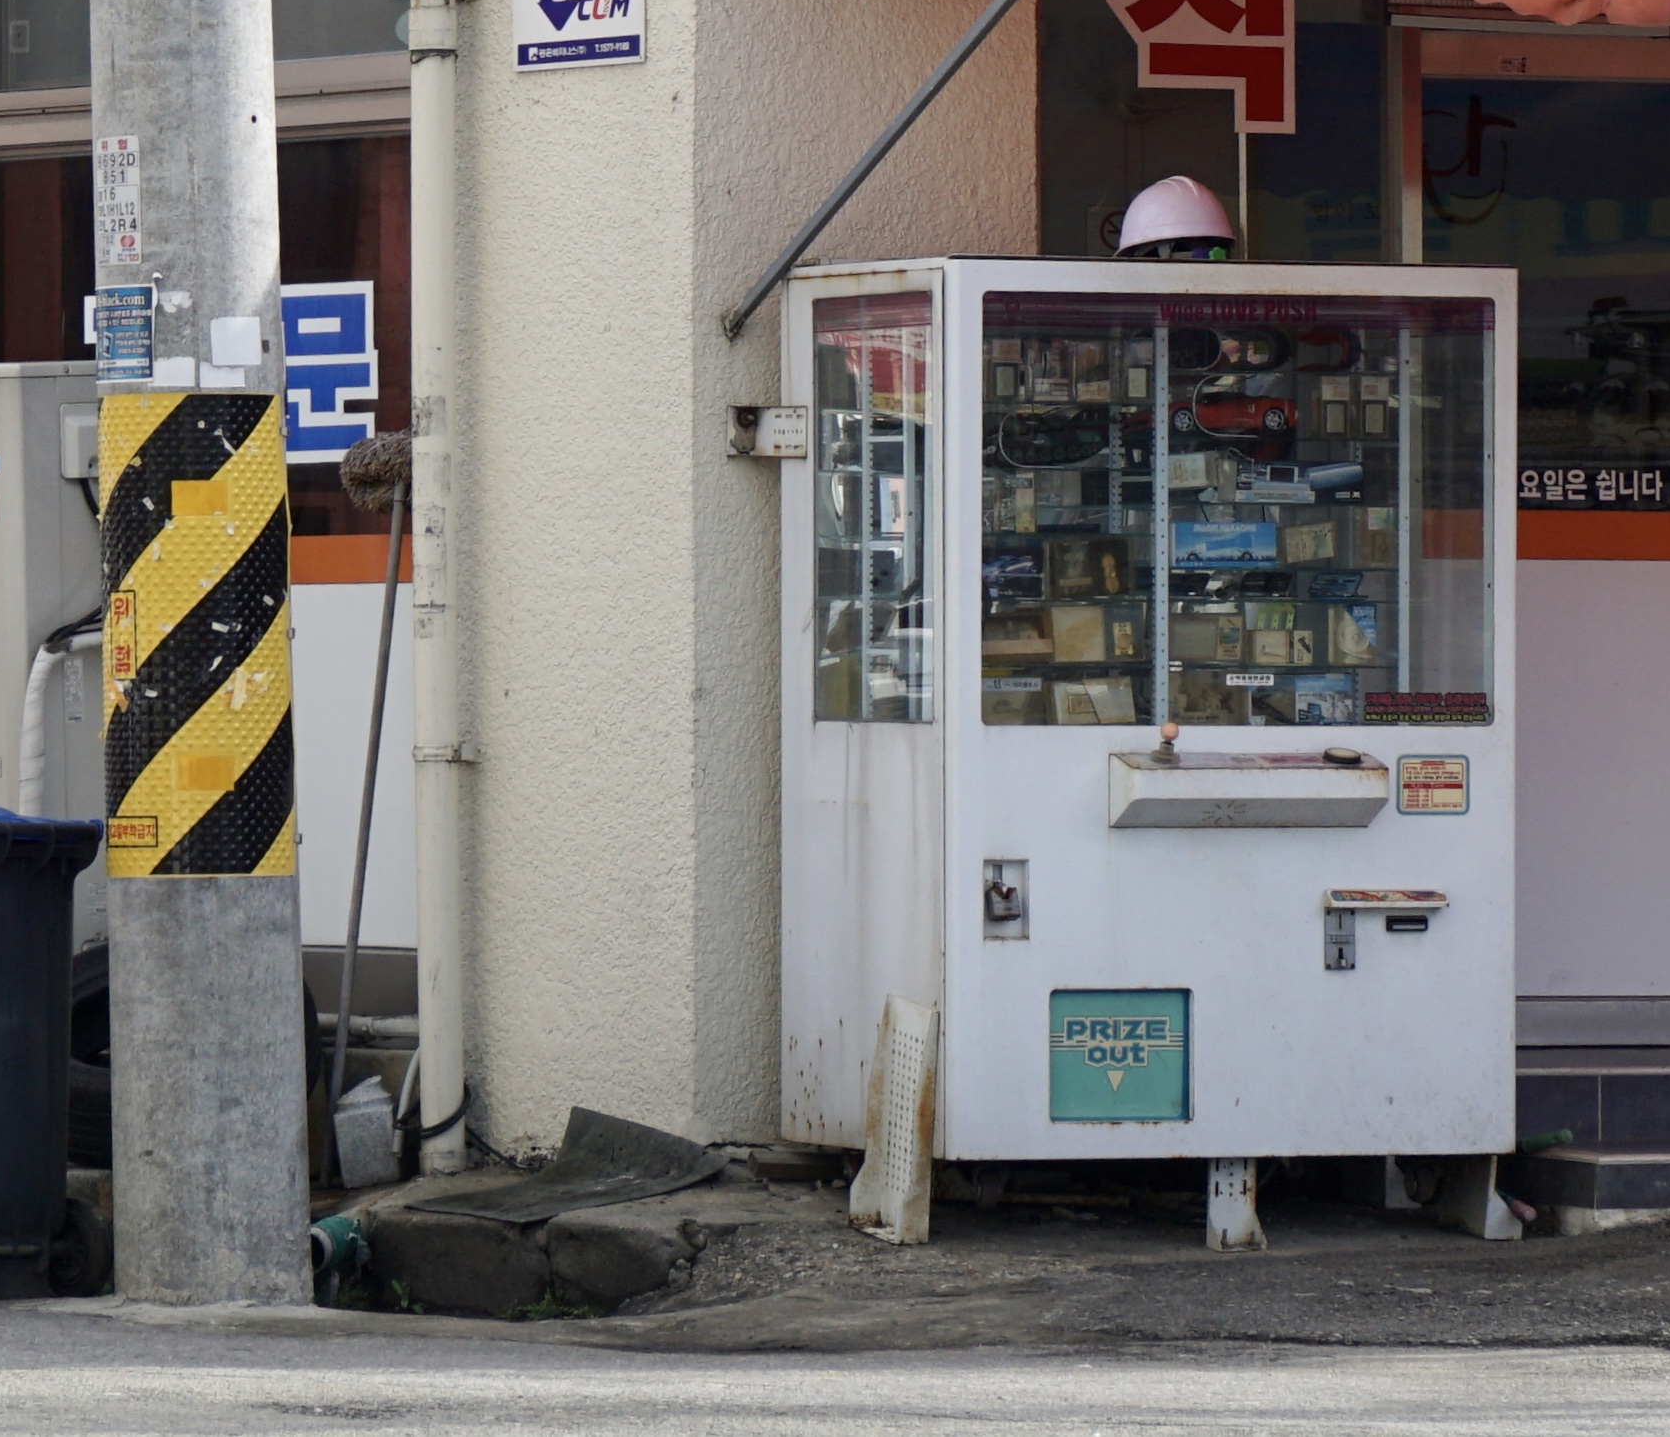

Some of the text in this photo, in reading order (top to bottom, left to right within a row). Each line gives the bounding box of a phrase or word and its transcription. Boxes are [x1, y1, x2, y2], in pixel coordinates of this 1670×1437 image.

[1211, 299, 1257, 322] LOVE
[1264, 299, 1318, 323] PUSH
[1595, 468, 1664, 502] 쉽니다
[1066, 1019, 1168, 1042] PRIZE
